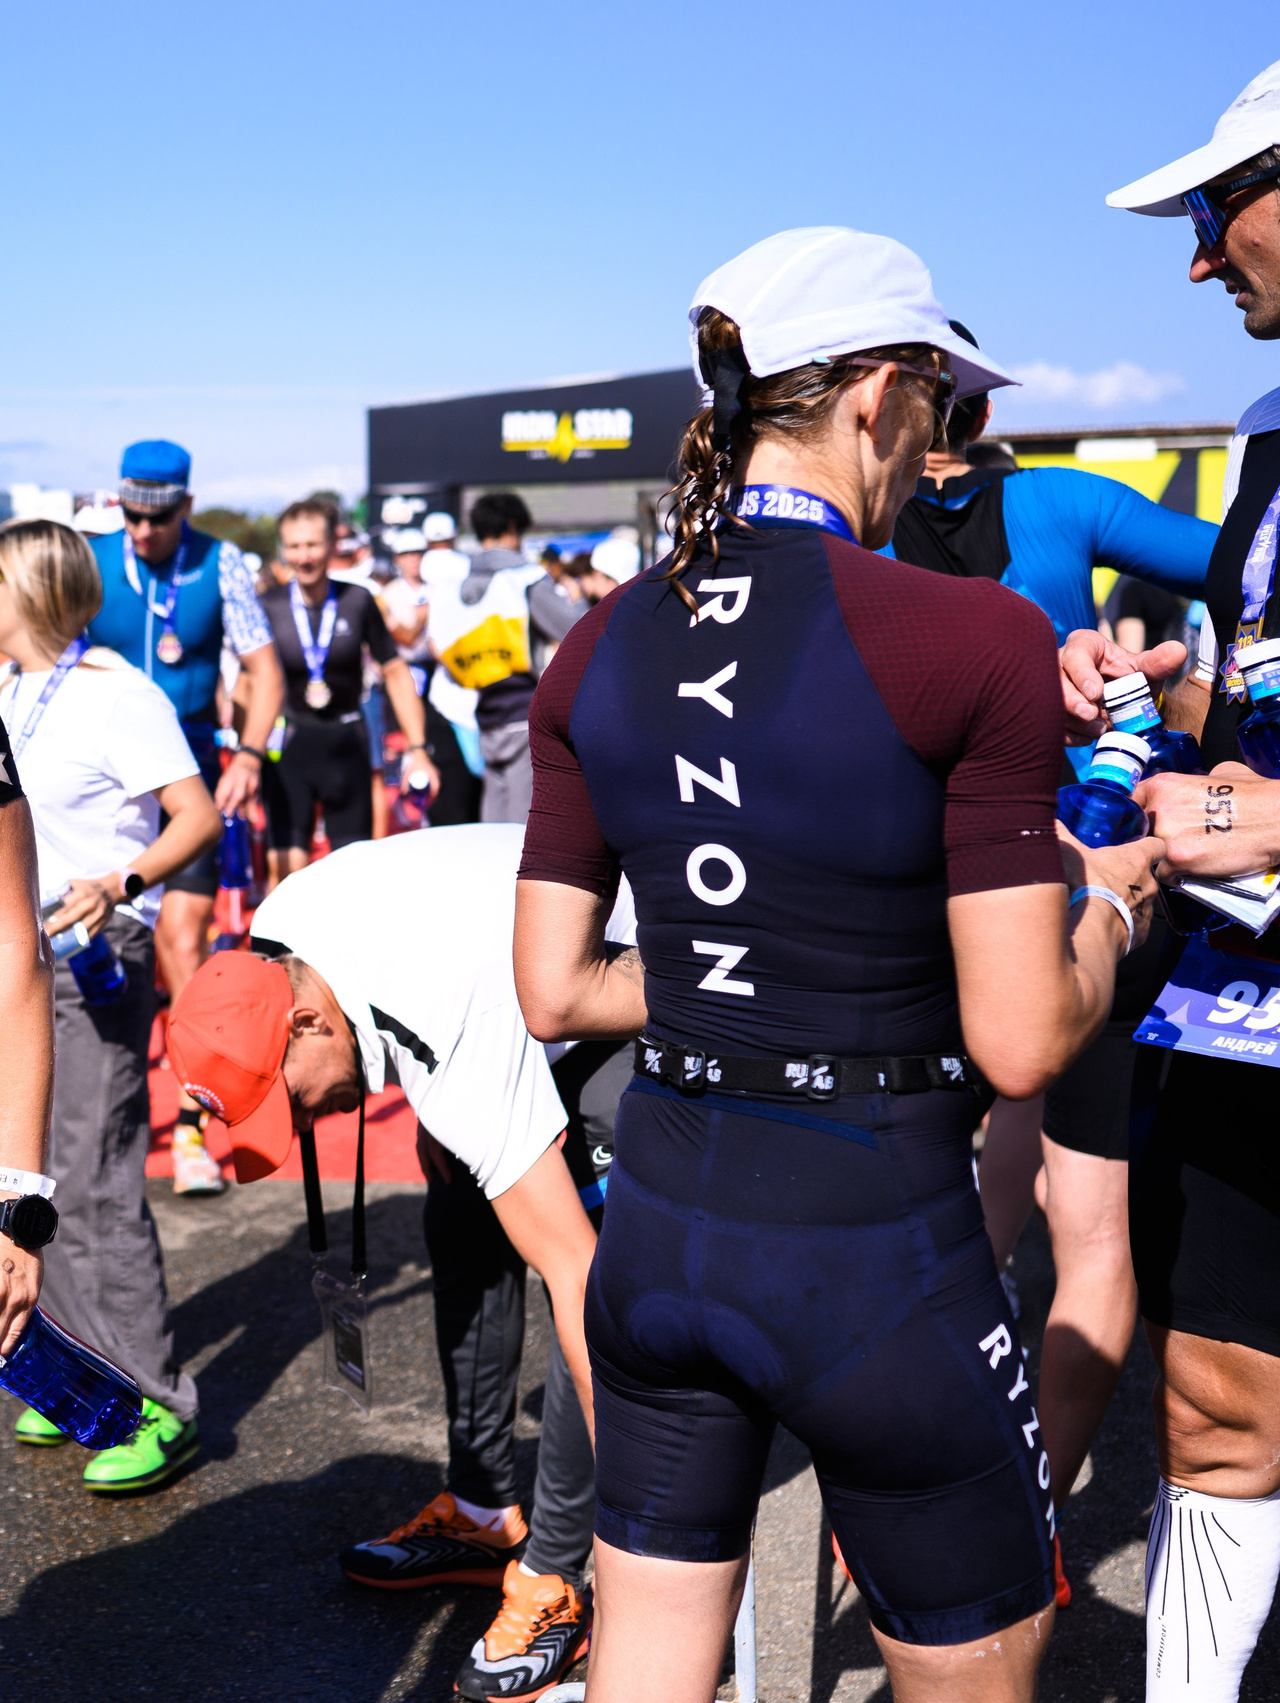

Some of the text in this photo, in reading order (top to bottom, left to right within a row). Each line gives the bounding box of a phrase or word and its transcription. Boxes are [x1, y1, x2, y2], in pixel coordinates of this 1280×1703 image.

[761, 492, 824, 521] 2025
[675, 576, 755, 997] RYZON
[1204, 784, 1234, 834] 952
[1206, 980, 1280, 1030] 95
[1211, 1036, 1279, 1056] АНДРЕЙ
[785, 1062, 809, 1079] RU
